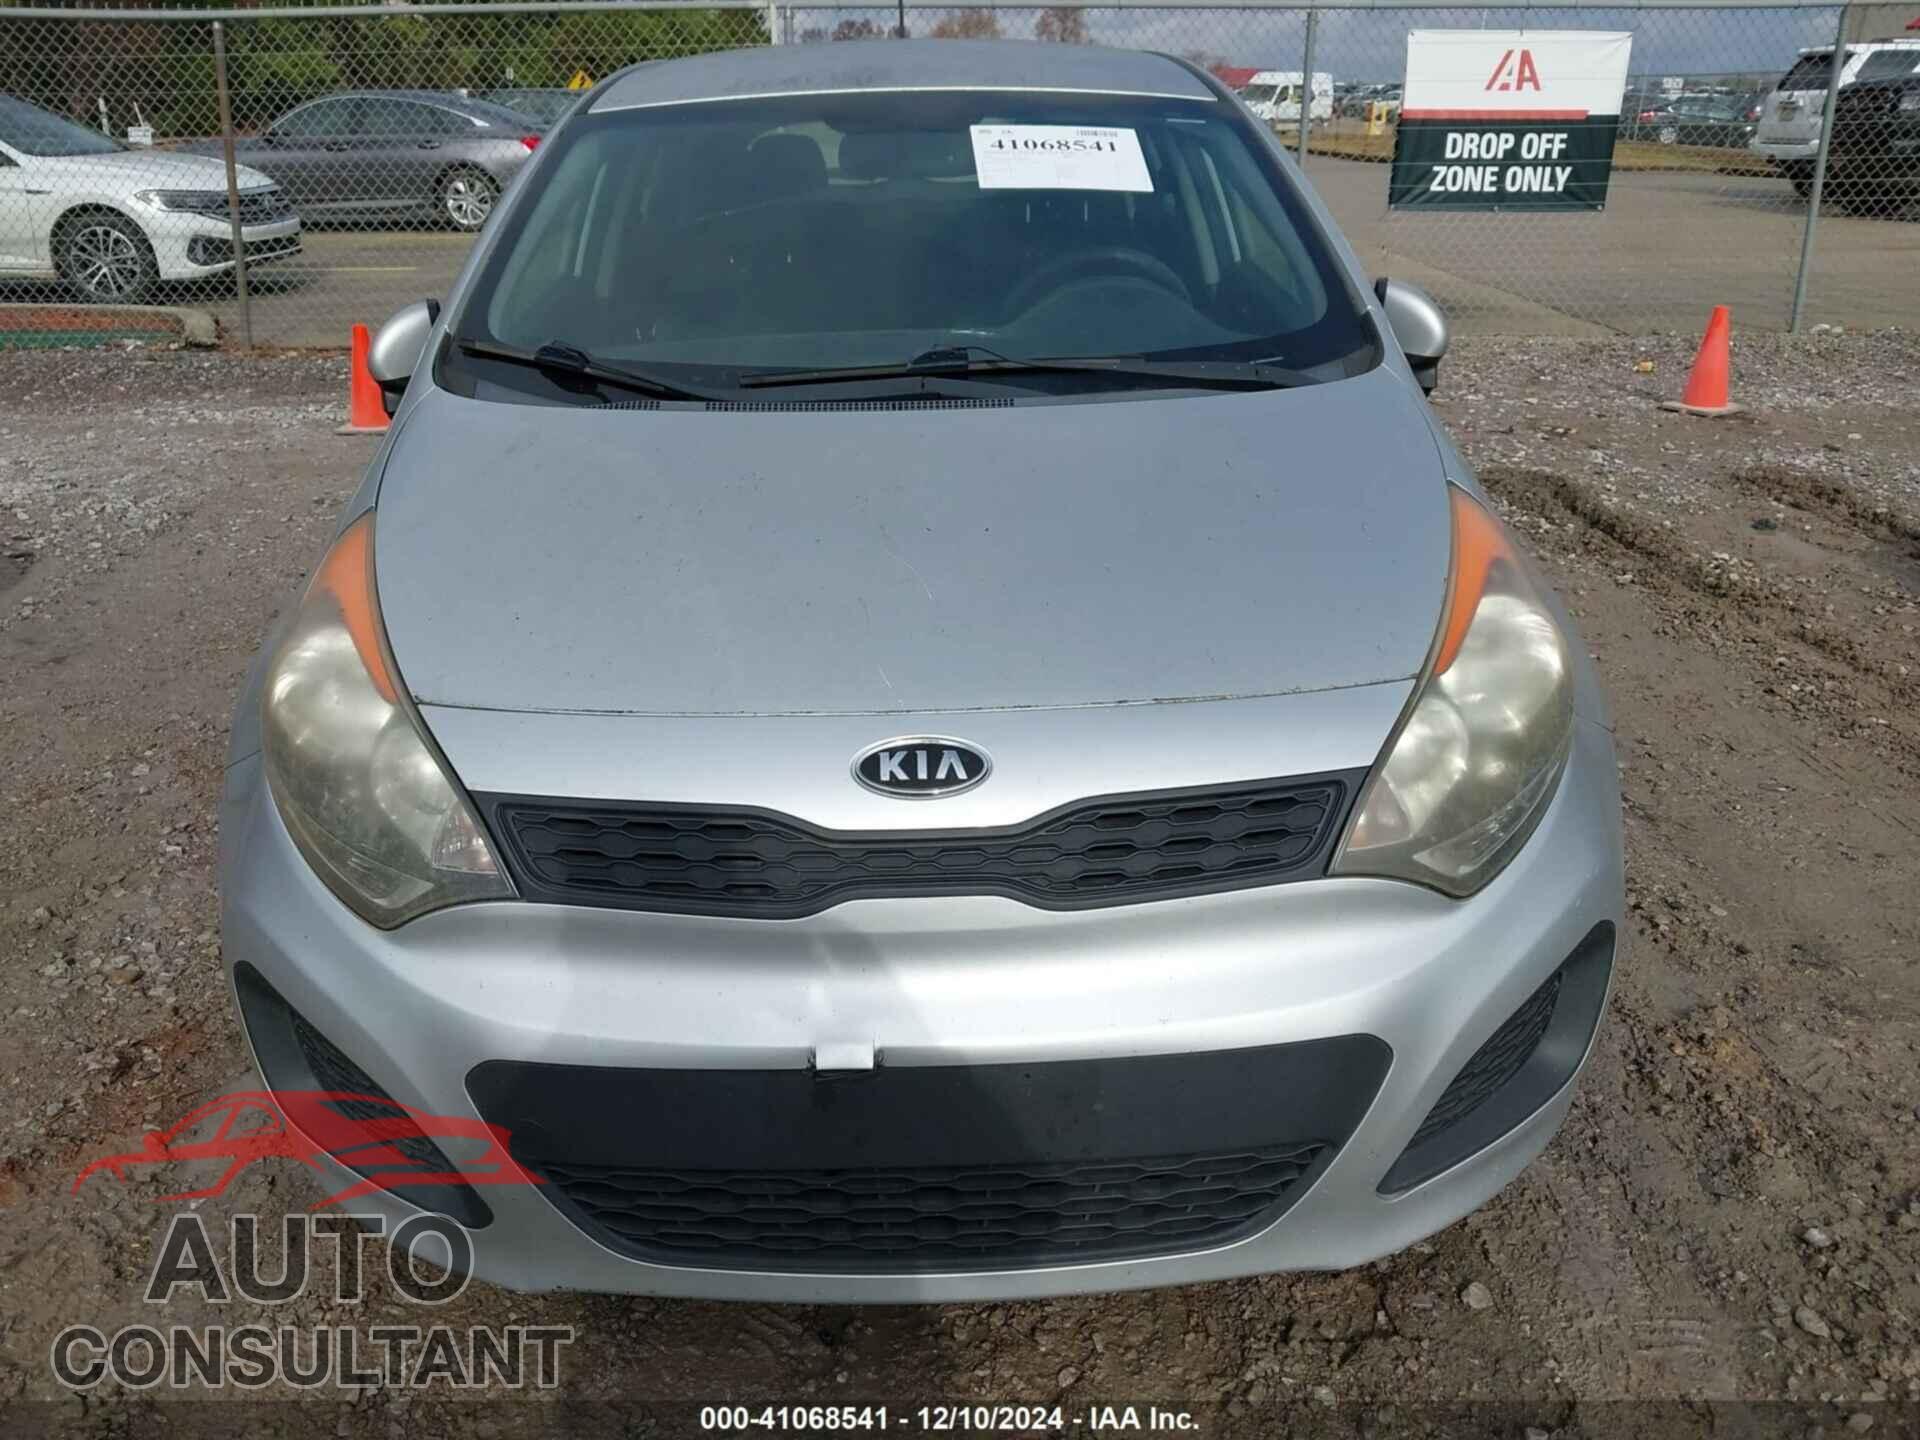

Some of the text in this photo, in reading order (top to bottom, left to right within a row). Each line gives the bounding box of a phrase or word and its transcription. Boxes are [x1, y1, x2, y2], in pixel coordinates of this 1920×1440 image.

[990, 138, 1117, 152] 41068541
[1444, 132, 1568, 160] DROP OFF
[1429, 165, 1572, 192] ZONE ONLY
[878, 750, 968, 781] KIA
